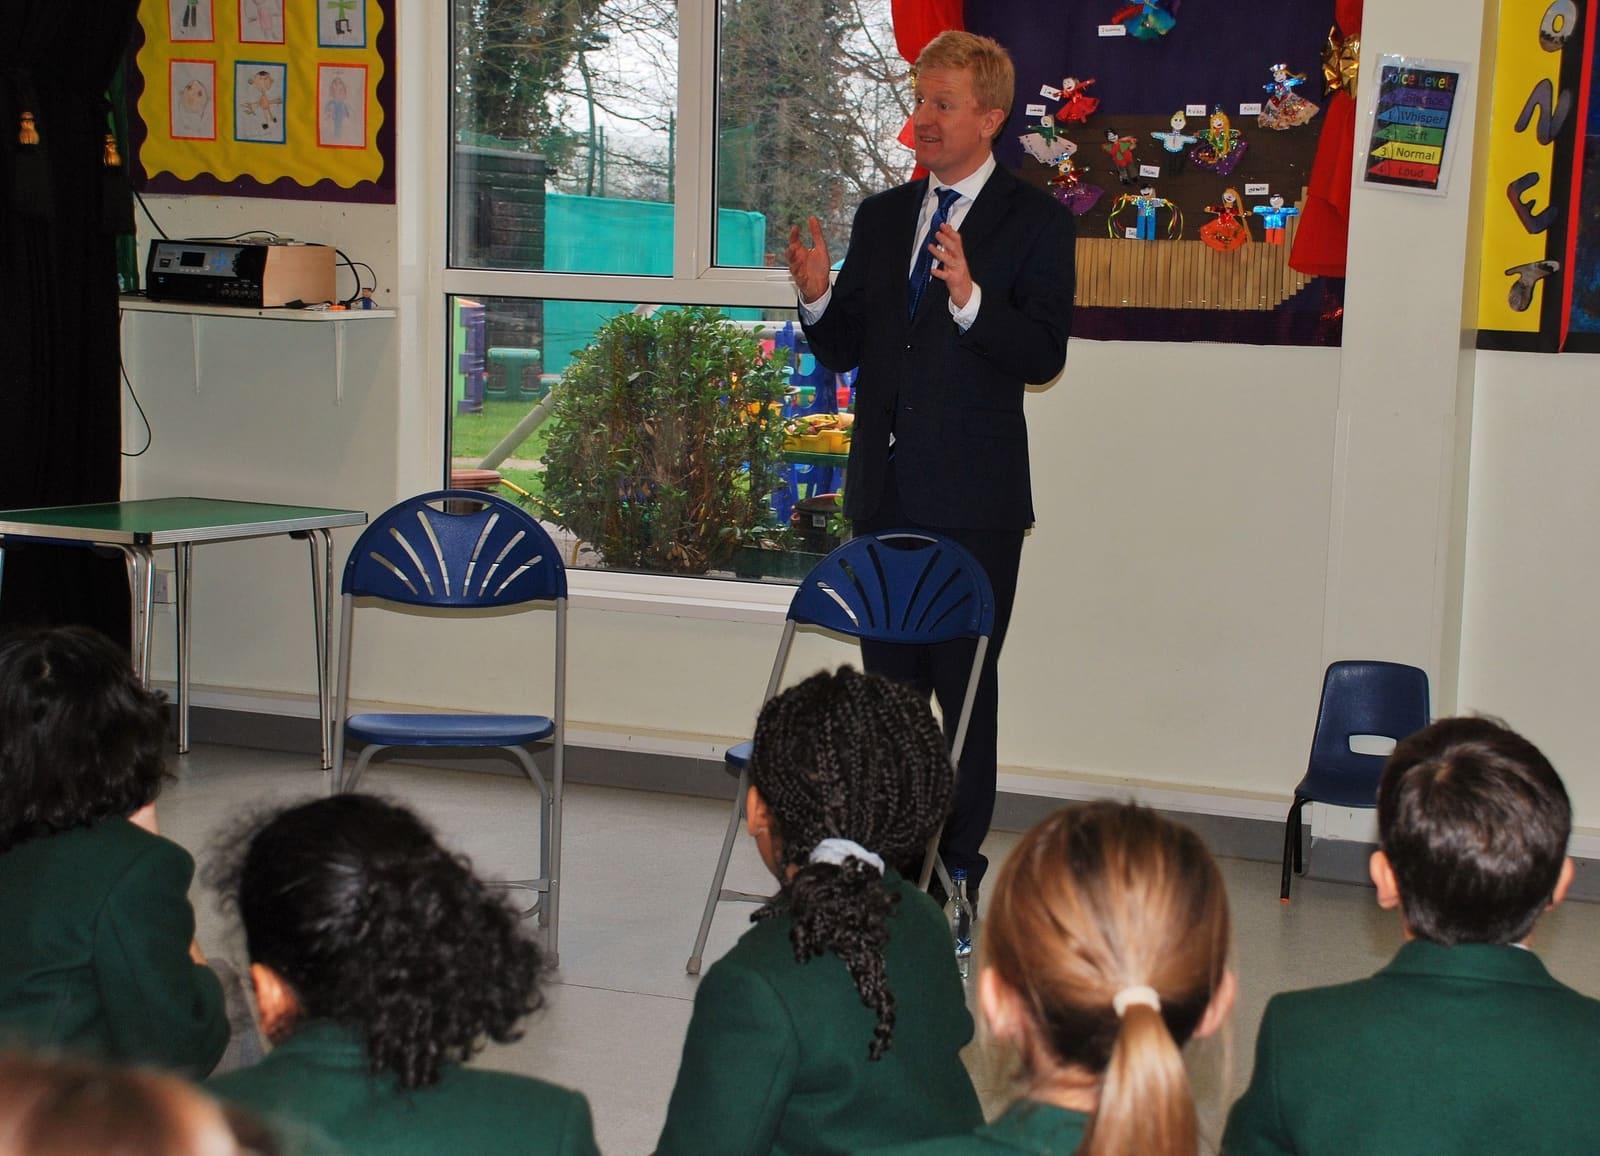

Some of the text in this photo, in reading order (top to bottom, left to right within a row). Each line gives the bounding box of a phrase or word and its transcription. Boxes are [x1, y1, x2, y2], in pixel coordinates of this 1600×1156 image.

[1384, 72, 1416, 87] oice
[1401, 111, 1444, 124] Whisper
[1396, 148, 1435, 160] Normal
[1398, 166, 1424, 178] Loud
